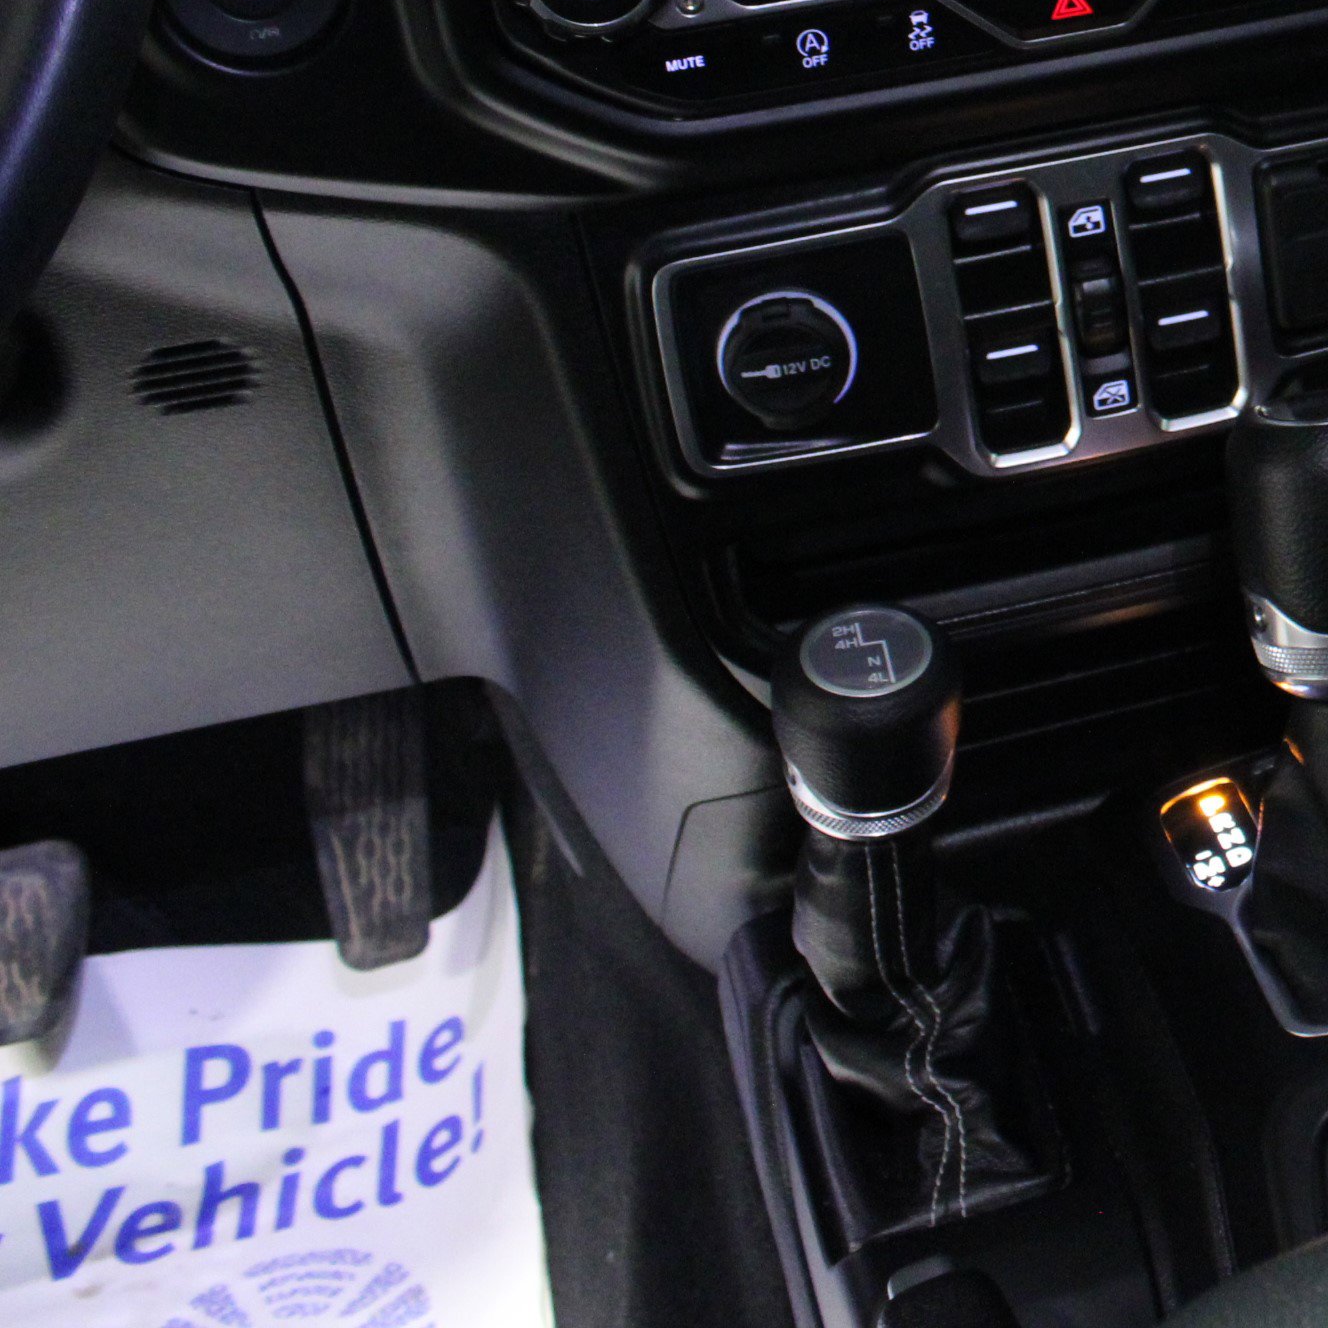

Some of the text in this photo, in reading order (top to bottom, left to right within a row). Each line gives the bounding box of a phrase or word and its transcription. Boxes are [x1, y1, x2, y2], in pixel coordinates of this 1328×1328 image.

[909, 36, 935, 51] OFF
[665, 53, 706, 73] MUTE
[802, 52, 829, 68] OFF
[783, 356, 831, 375] 12V DC
[832, 624, 855, 637] 2H
[835, 636, 858, 650] 4H
[867, 655, 881, 667] N
[868, 672, 889, 684] 4L
[180, 1016, 465, 1147] Pride
[37, 1061, 484, 1282] Vehicle!
